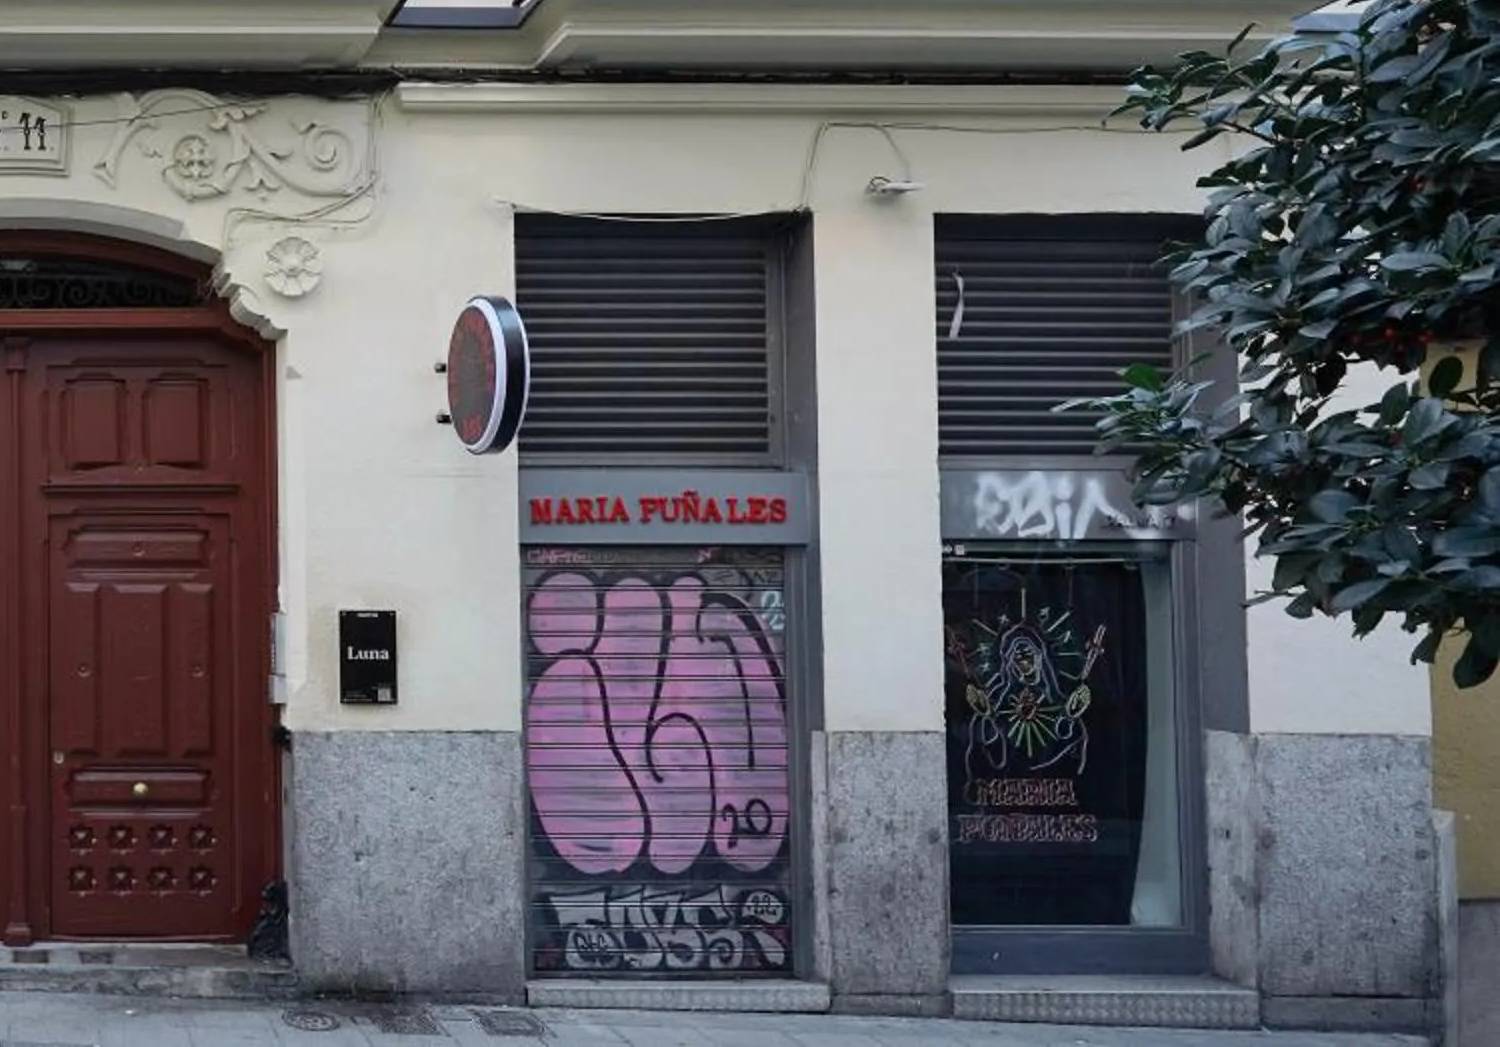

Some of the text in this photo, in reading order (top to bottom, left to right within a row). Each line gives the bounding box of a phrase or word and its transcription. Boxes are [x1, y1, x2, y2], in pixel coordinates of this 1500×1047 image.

[529, 489, 787, 525] MARIA PUÑALES
[347, 646, 389, 660] Luna
